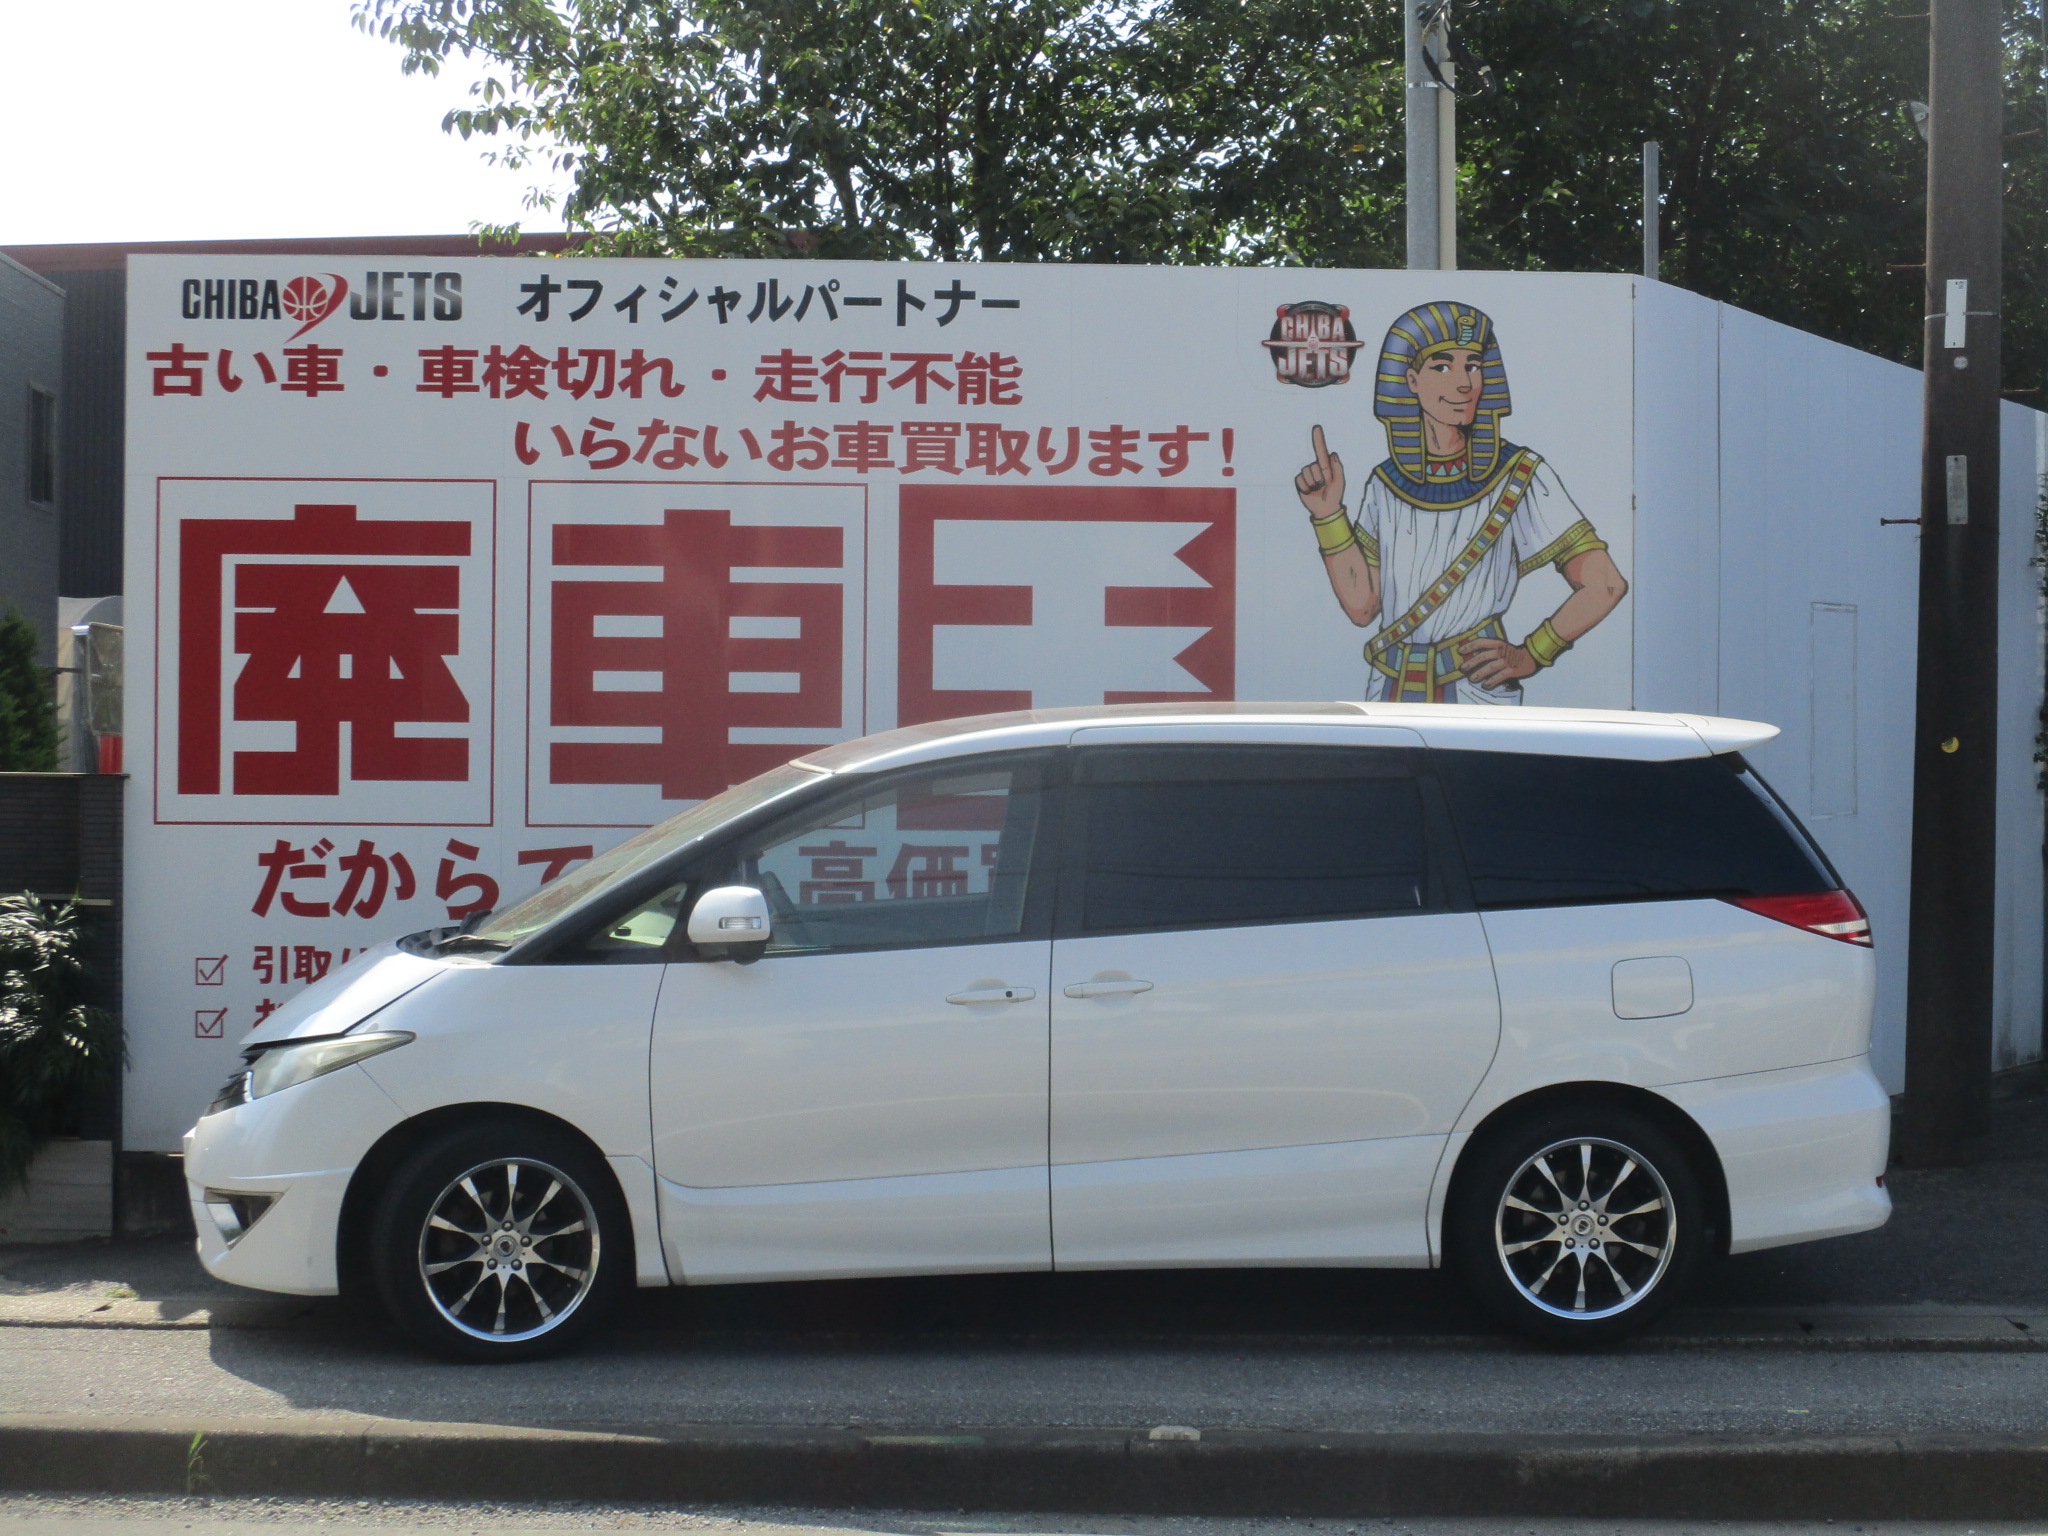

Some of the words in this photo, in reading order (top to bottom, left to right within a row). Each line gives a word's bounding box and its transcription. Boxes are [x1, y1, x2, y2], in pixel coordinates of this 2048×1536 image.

[182, 279, 281, 320] CHIBA
[350, 271, 462, 322] JETS
[518, 274, 1020, 327] オフィシャルパートナー
[1281, 313, 1346, 341] CHIBA
[1278, 347, 1348, 379] JETS
